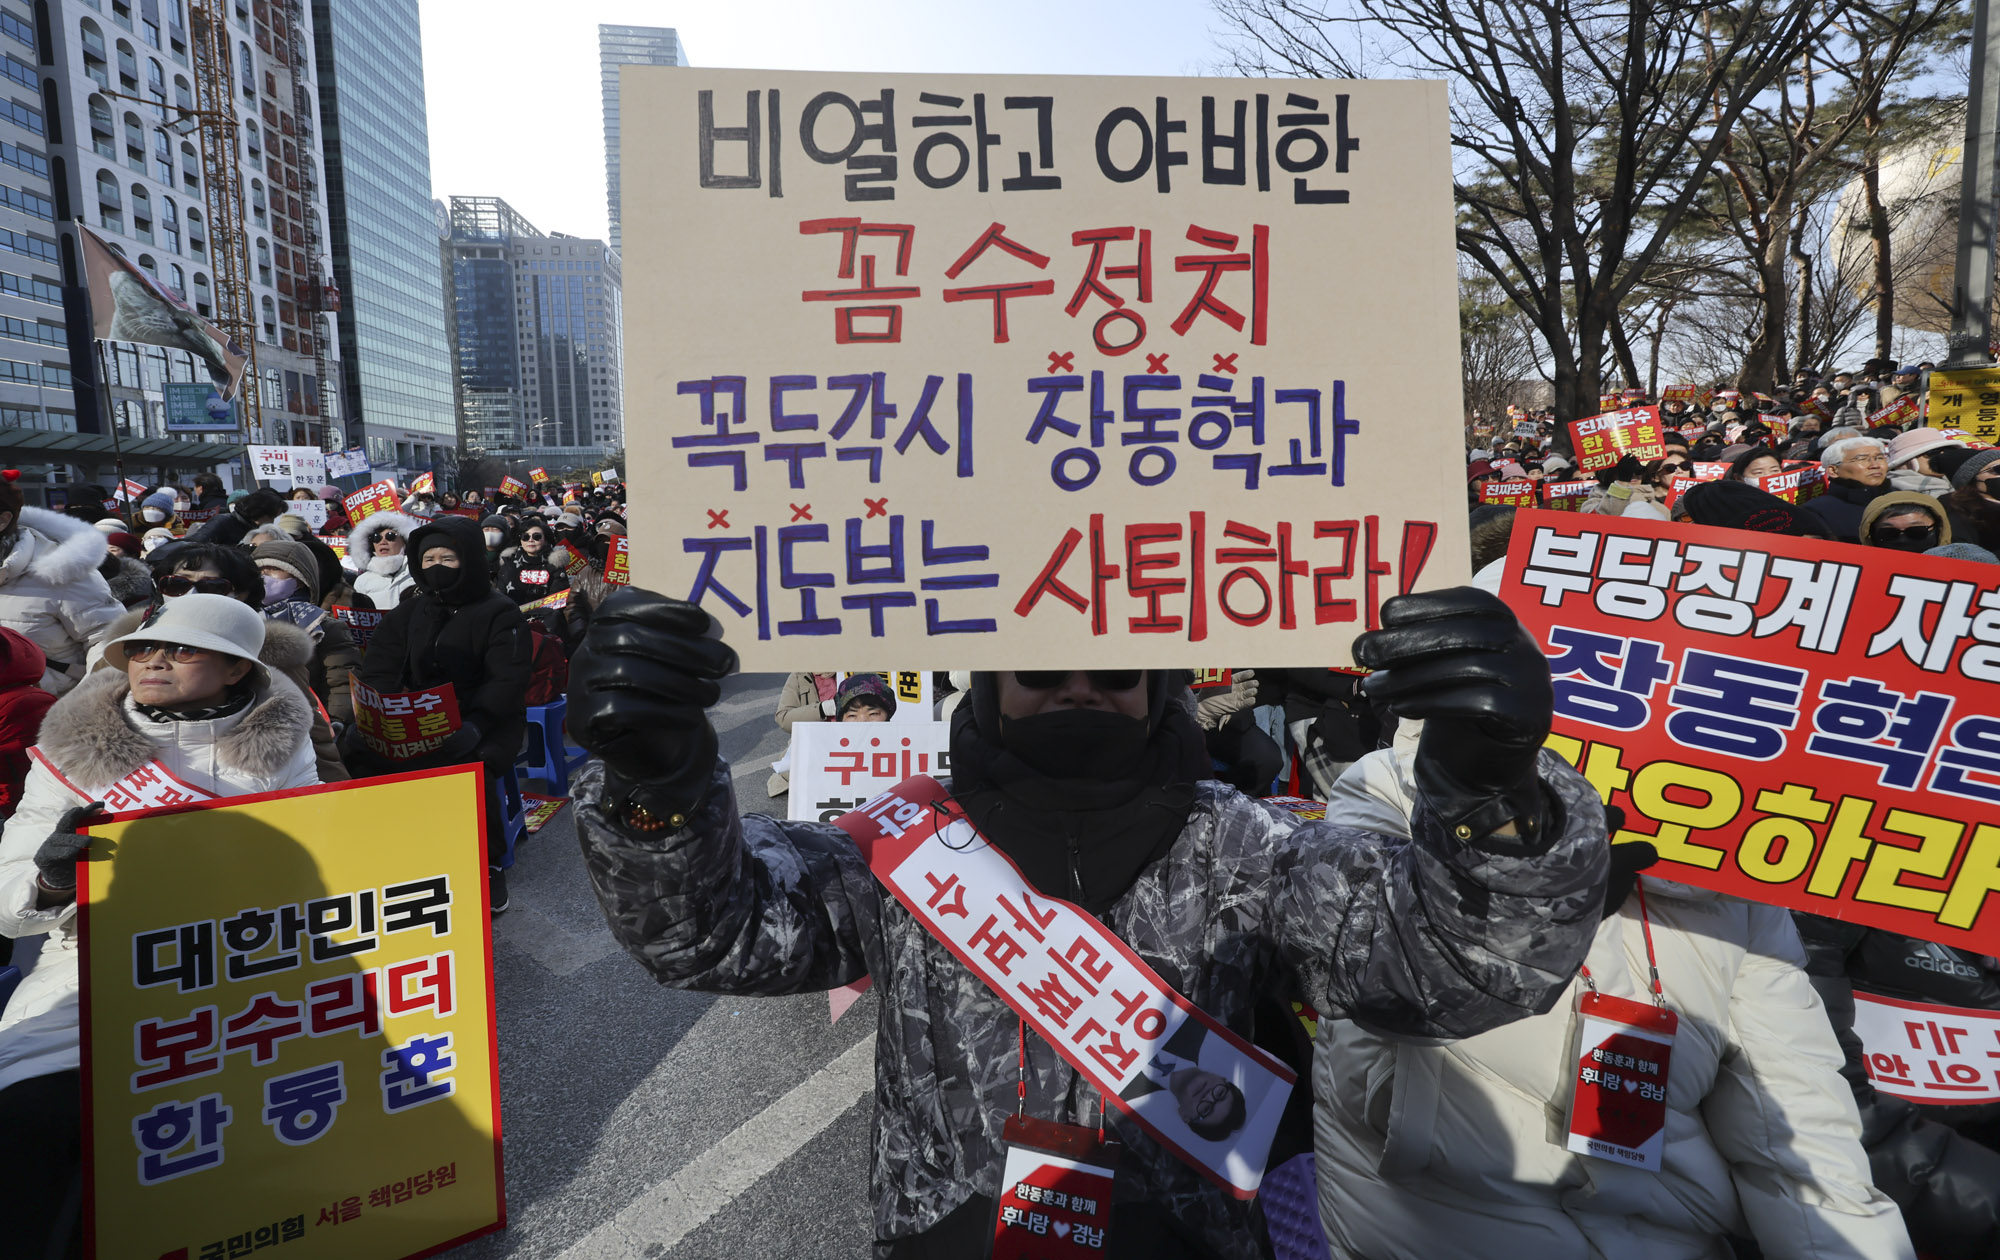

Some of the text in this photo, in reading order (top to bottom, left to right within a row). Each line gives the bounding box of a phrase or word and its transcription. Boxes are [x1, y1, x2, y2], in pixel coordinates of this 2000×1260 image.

[700, 88, 1361, 205] 비열하고 야비한
[799, 217, 1270, 357] 꼼수정치
[671, 369, 1361, 493] 꼭두각시 장동혁과
[1576, 409, 1652, 436] 진짜보수
[1582, 451, 1618, 470] 우리가
[345, 483, 389, 511] 진짜보수
[1486, 483, 1532, 496] 진짜보수
[1767, 465, 1827, 494] 진짜보수
[683, 511, 1438, 643] 지도부는 사퇴하라!
[1522, 527, 1863, 655] 부당징계
[336, 608, 383, 627] 부당징계
[353, 680, 442, 717] 진짜보수
[356, 706, 450, 741] 한동훈
[134, 875, 451, 992] 대한민국
[1904, 956, 1980, 978] adidas
[134, 954, 453, 1089] 보수리더
[1592, 1047, 1659, 1077] 한동훈과 함께
[1580, 1066, 1666, 1102] 후니랑 경남
[1587, 1141, 1646, 1163] 국민의힘 책임당원
[199, 1161, 457, 1260] 국민의힘 서울 책임당원
[1016, 1181, 1097, 1216] 한동훈과 함께
[1001, 1206, 1105, 1248] 후니랑 경남
